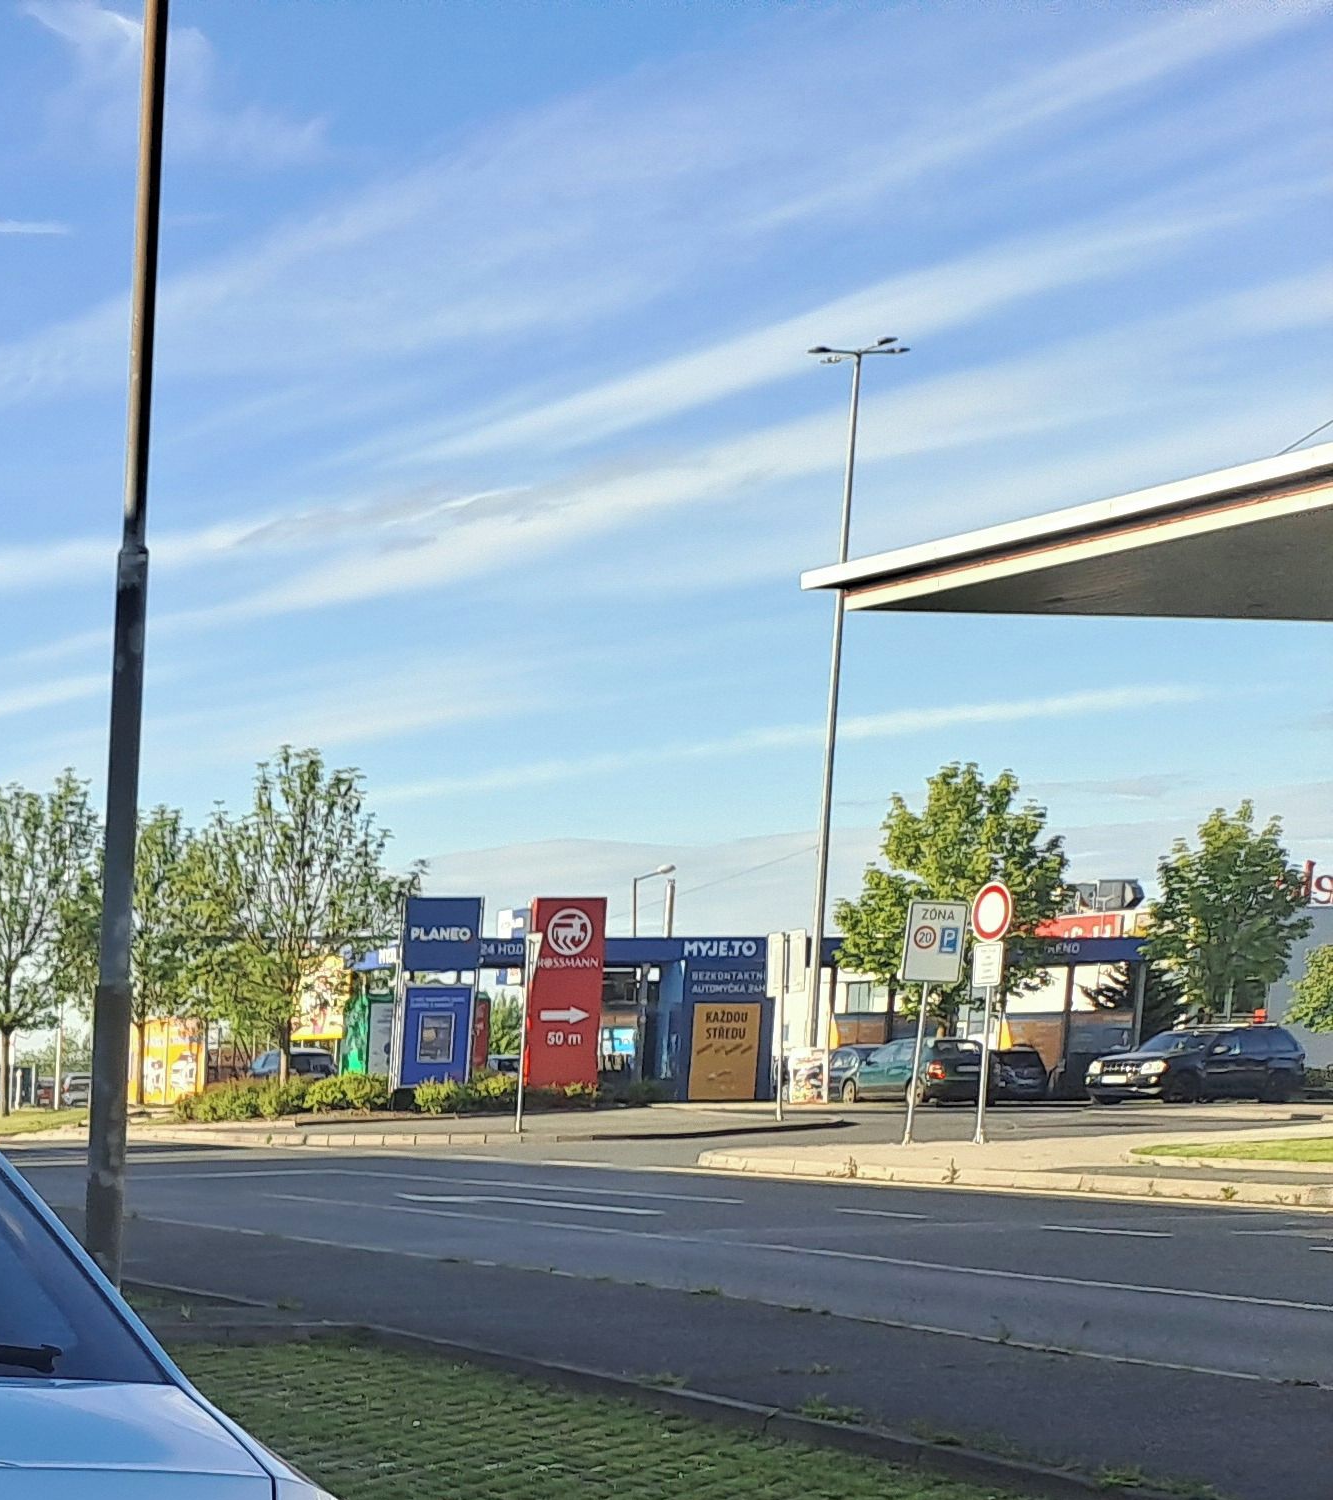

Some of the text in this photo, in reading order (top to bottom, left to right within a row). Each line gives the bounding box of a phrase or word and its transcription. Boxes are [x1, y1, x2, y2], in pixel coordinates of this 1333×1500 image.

[921, 907, 955, 921] ZÓNA
[410, 926, 471, 942] PLANEO
[918, 931, 932, 944] 20
[683, 940, 757, 957] MYJE.TO
[537, 956, 599, 969] ROSSMANN
[705, 1010, 749, 1024] KAŽDOU
[546, 1031, 582, 1046] 50 m
[705, 1025, 747, 1041] STŘEDU
